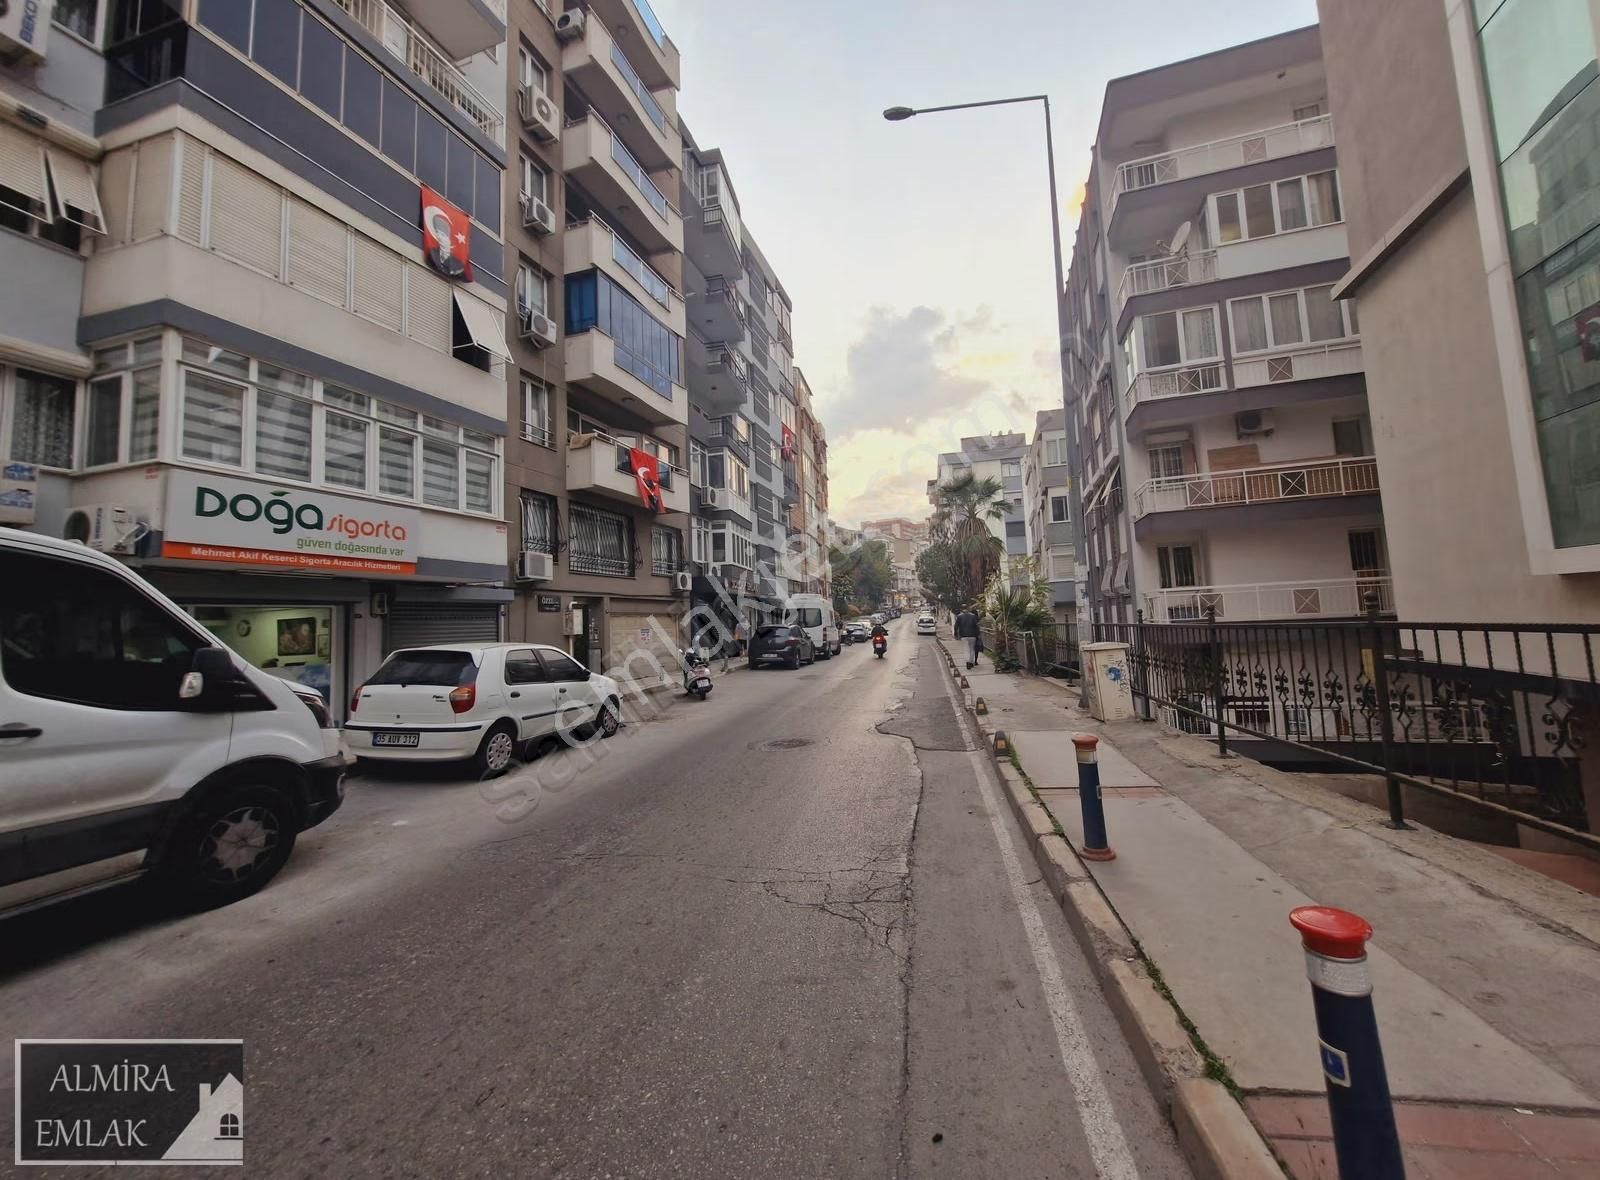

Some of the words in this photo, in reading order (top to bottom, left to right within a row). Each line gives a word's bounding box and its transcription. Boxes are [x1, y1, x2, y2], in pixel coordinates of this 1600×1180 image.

[195, 486, 324, 534] Doğa
[326, 514, 406, 541] sigorta
[297, 537, 331, 550] güven
[335, 540, 387, 555] doğasında
[389, 548, 404, 557] var
[191, 546, 237, 559] Mehmet
[238, 550, 260, 560] Akif
[262, 552, 298, 564] Keserci
[299, 555, 331, 566] Sigorta
[332, 558, 363, 568] Aracılık
[364, 560, 401, 571] Hizmetleri
[377, 735, 385, 743] 35
[403, 735, 417, 743] 312
